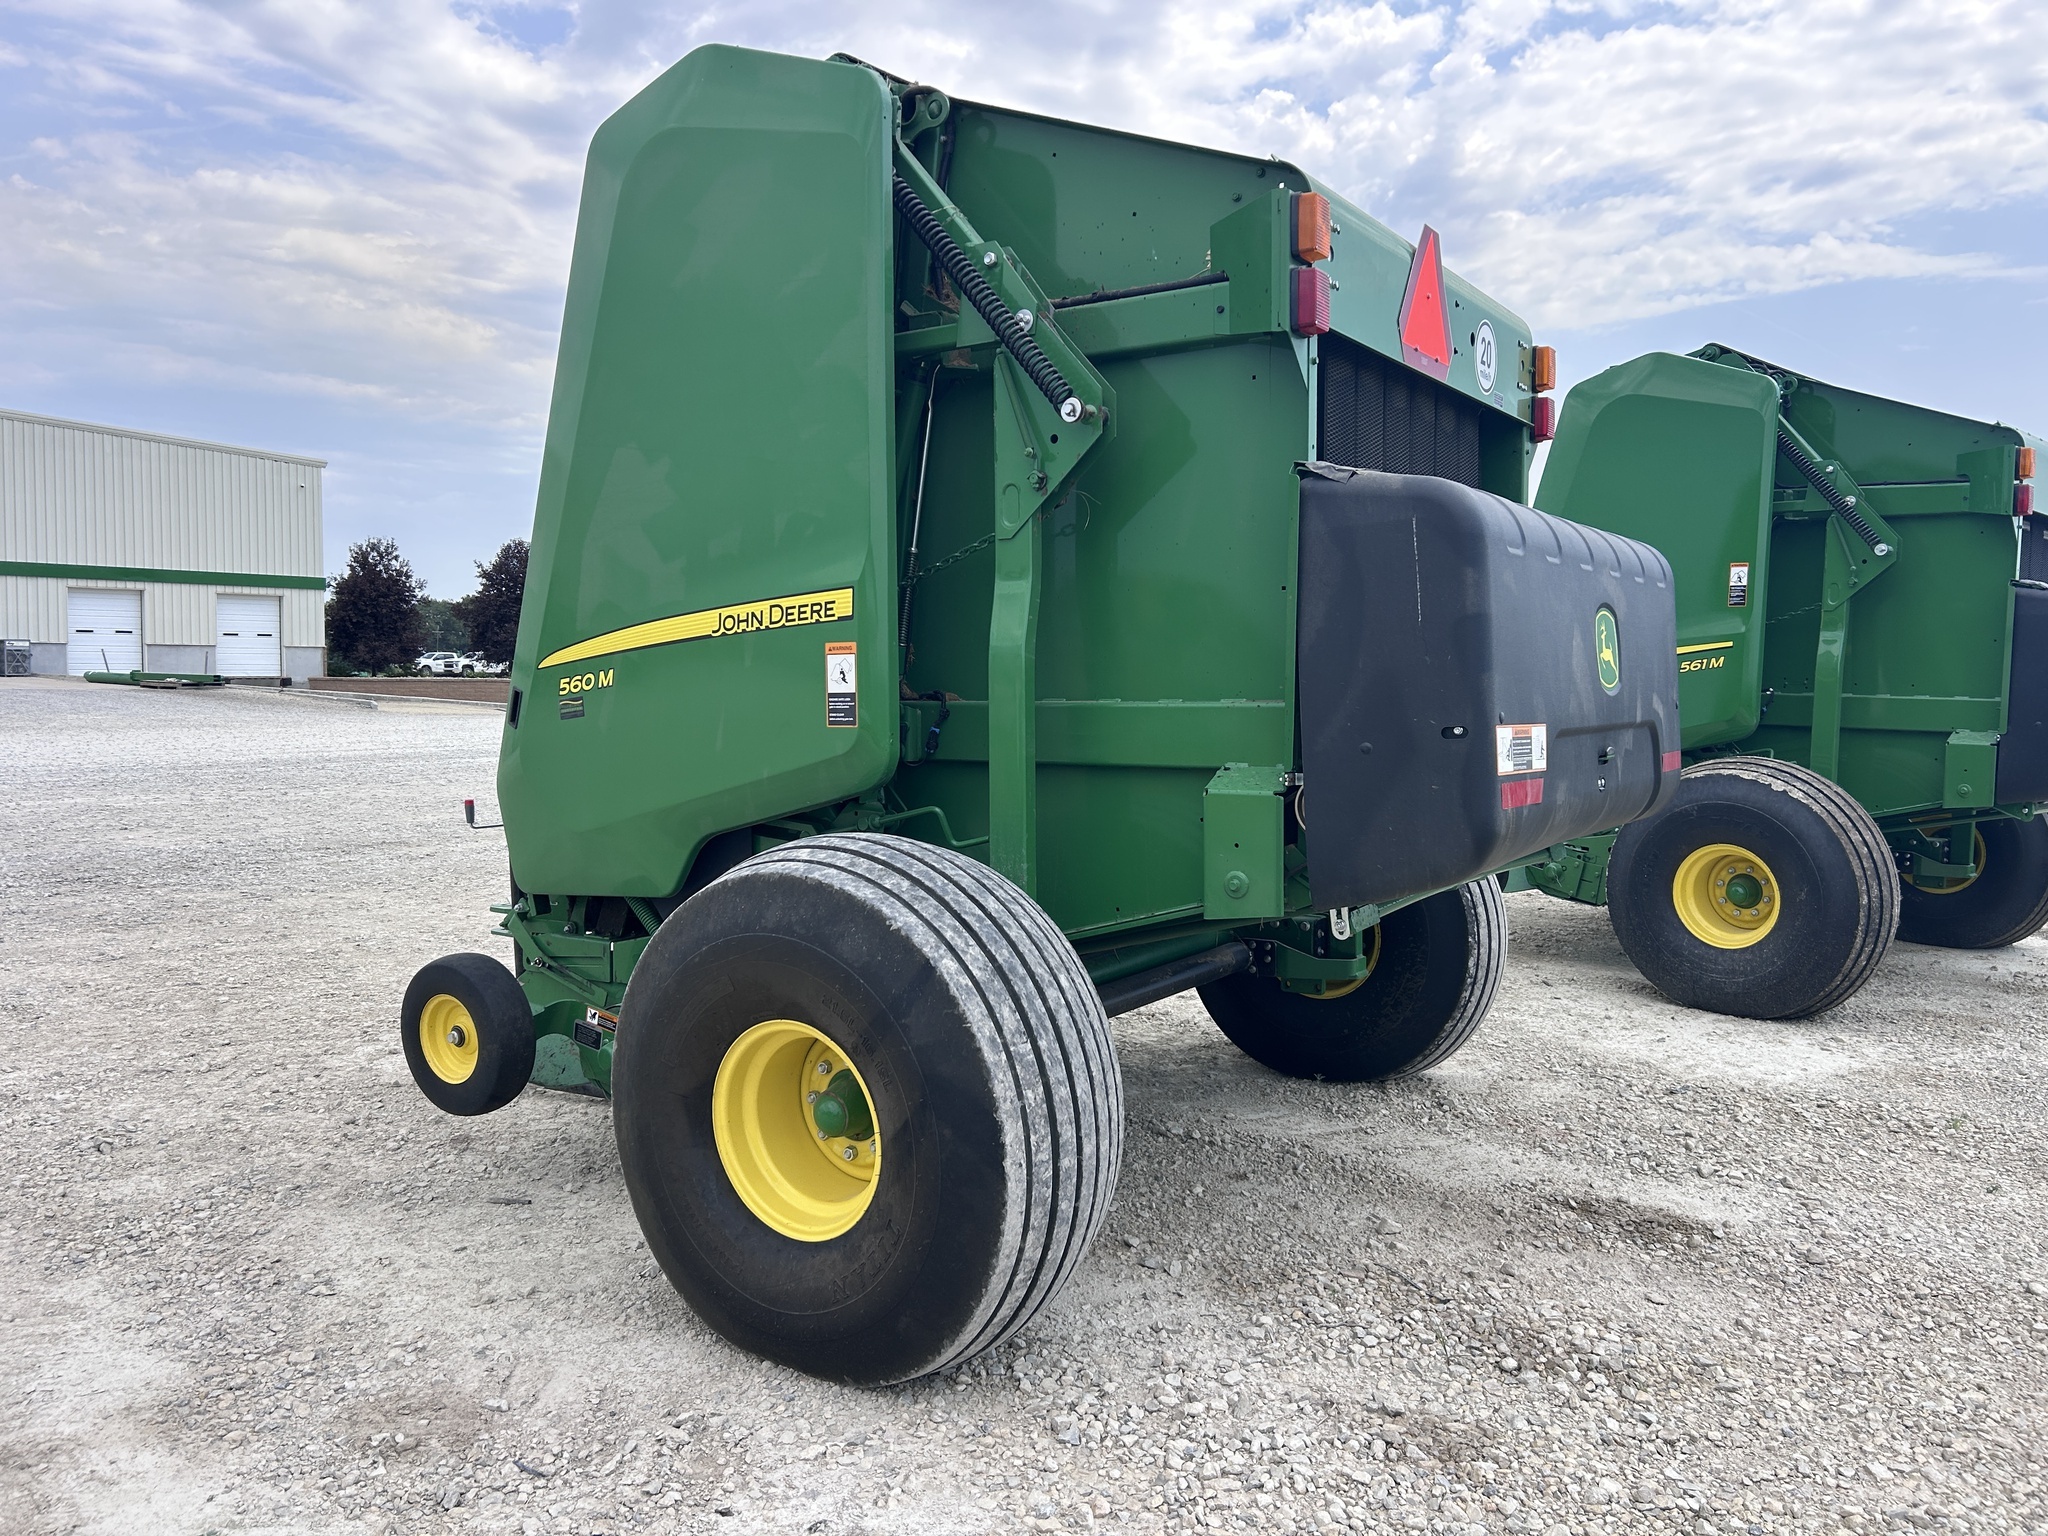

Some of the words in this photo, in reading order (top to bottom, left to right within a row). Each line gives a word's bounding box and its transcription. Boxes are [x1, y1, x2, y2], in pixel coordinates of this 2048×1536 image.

[1480, 336, 1492, 369] 20
[712, 609, 764, 634] JOHN
[769, 600, 836, 625] DEERE
[1679, 658, 1708, 673] 561
[1708, 655, 1725, 669] M
[559, 672, 596, 696] 560
[598, 668, 615, 689] M
